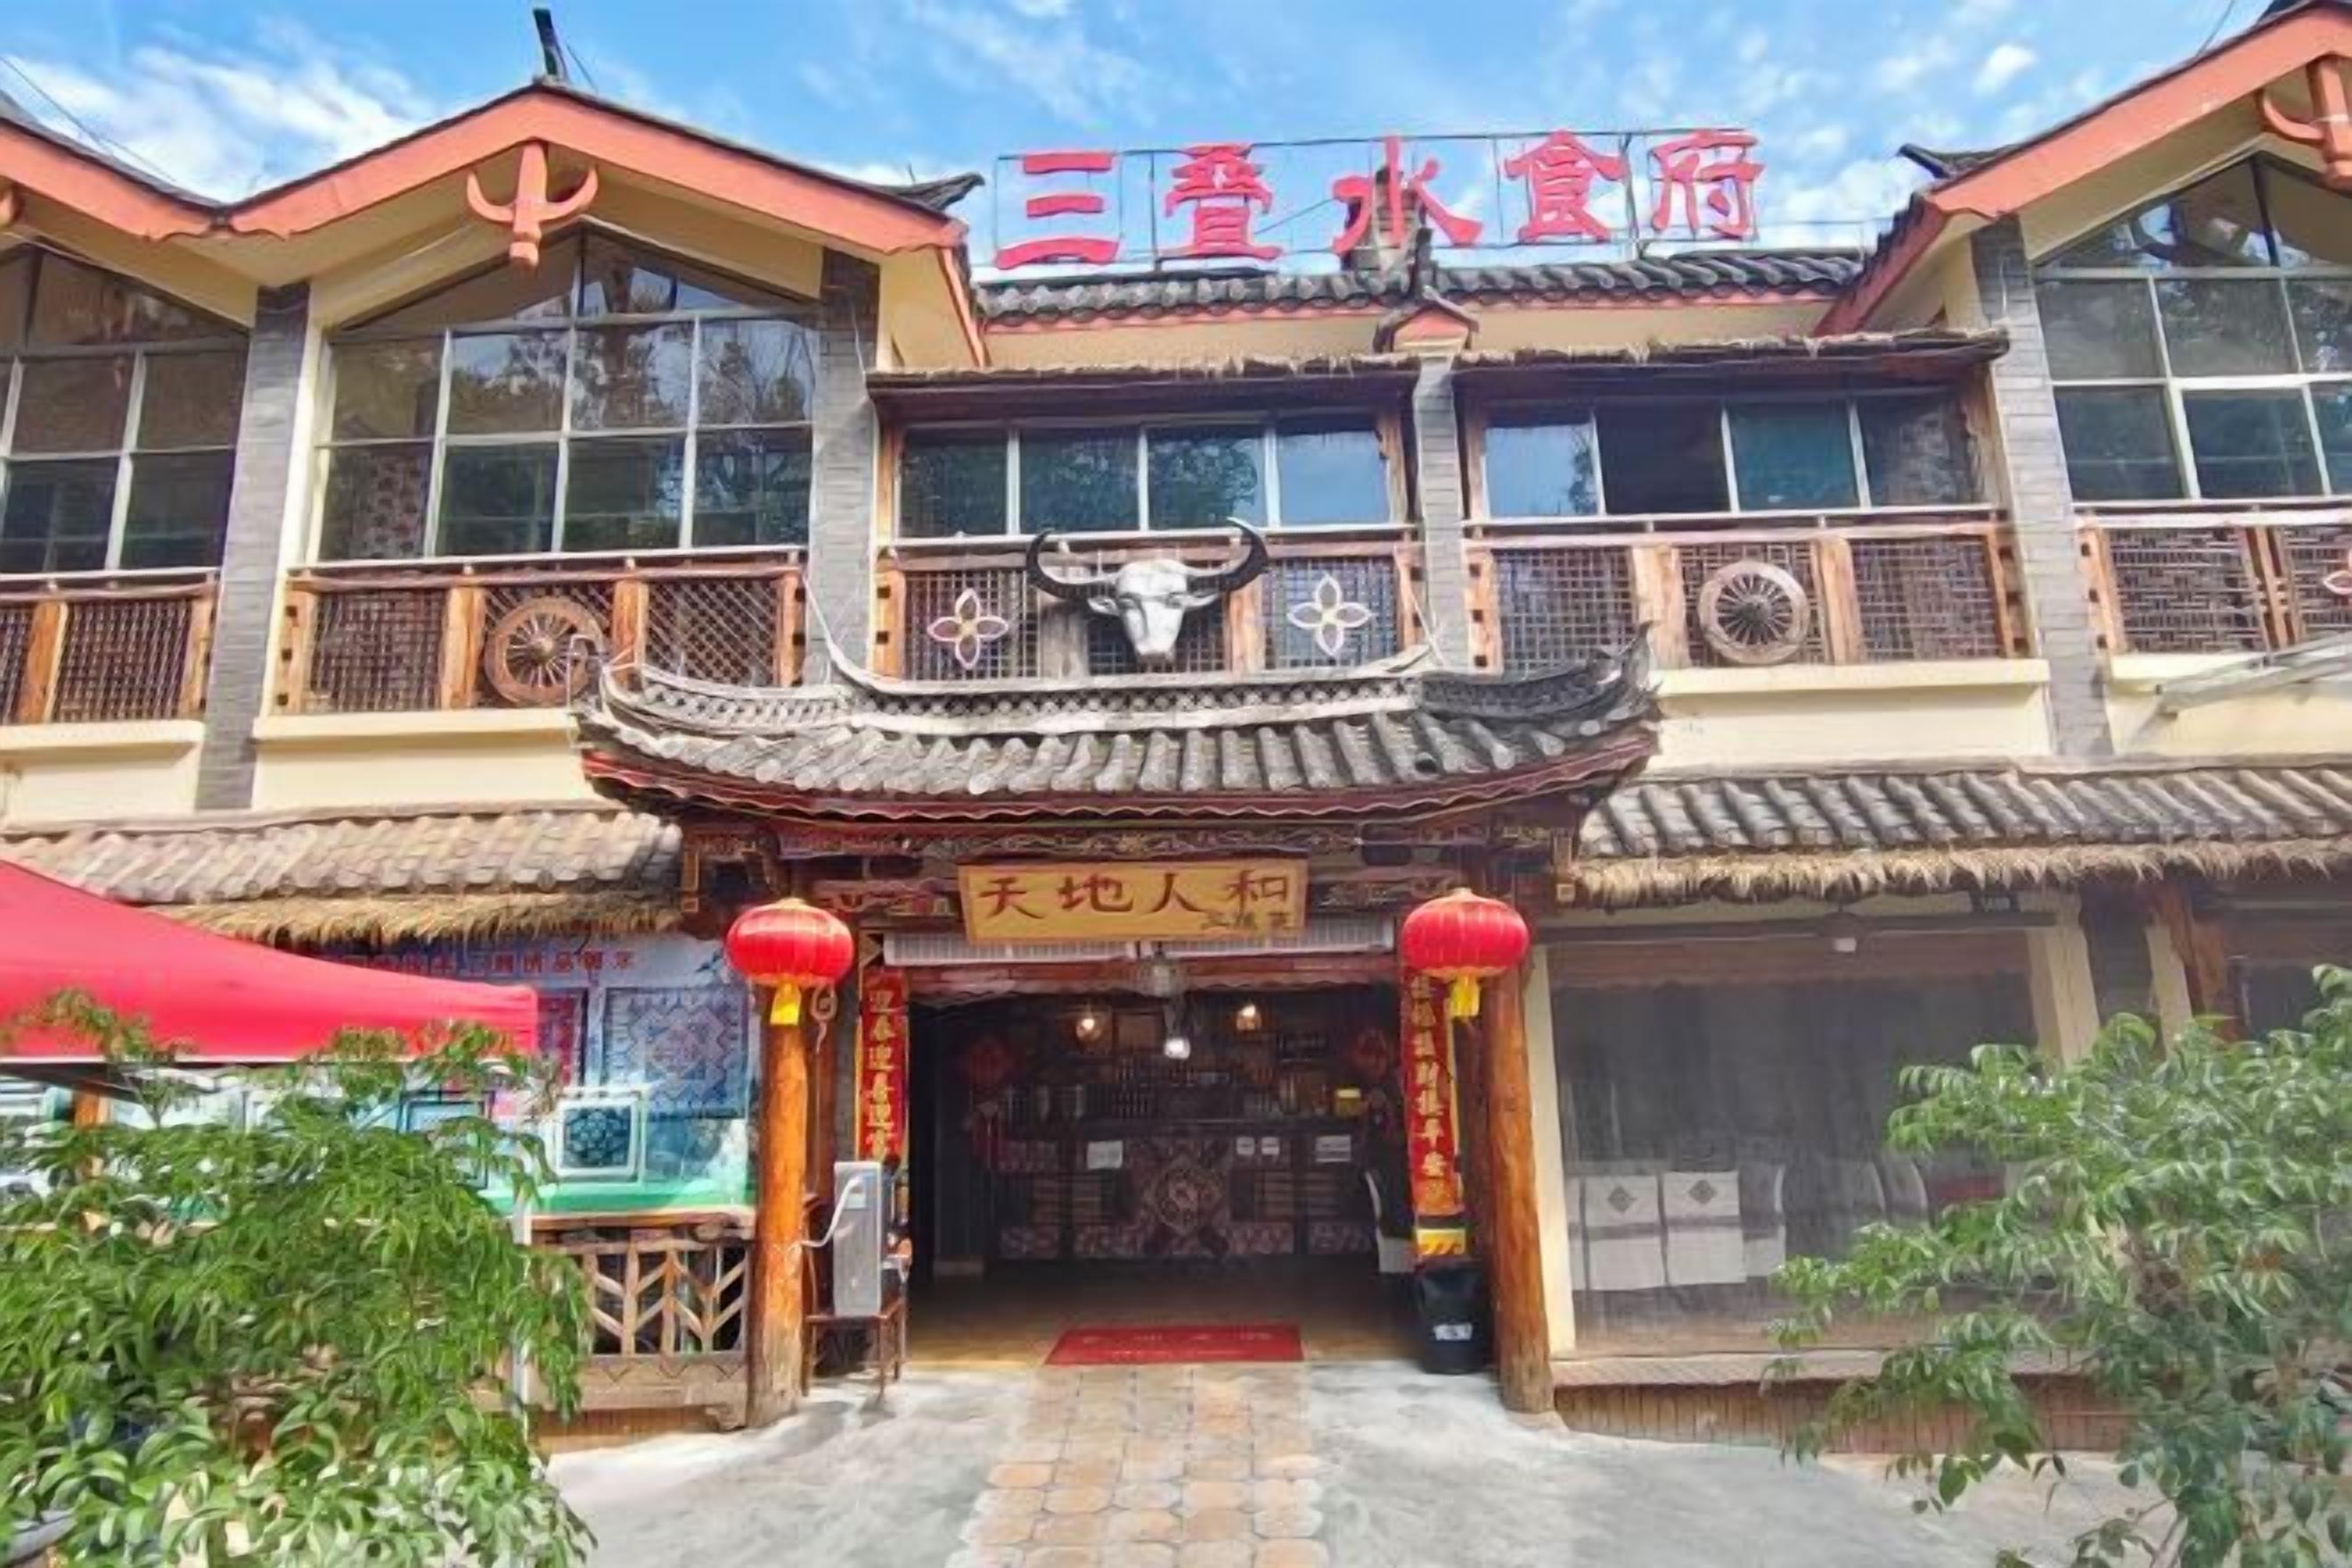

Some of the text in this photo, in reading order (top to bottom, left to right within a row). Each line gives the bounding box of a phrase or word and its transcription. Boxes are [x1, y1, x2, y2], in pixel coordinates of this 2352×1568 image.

[995, 128, 1764, 268] 三叠水食府
[978, 869, 1288, 920] 天地人和
